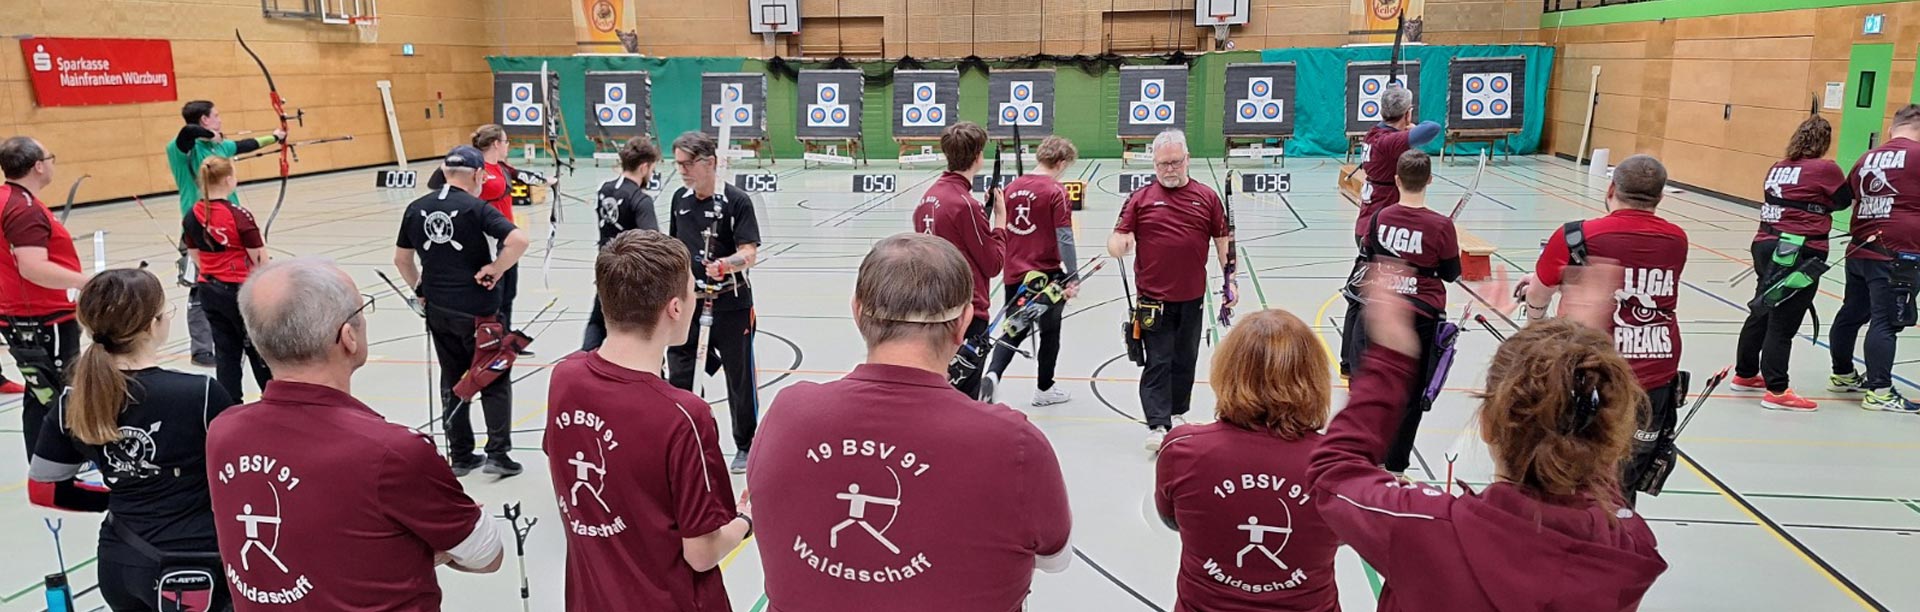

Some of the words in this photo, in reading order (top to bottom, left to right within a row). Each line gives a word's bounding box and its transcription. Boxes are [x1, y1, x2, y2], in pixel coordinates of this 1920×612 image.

[56, 57, 110, 73] Sparkasse
[60, 72, 123, 86] Mainfranken
[123, 72, 168, 86] Würzburg
[1863, 150, 1907, 169] LIGA
[385, 171, 416, 188] 000
[745, 174, 777, 191] 052
[863, 175, 895, 192] 050
[1254, 174, 1290, 192] 036
[1767, 166, 1802, 185] LIGA
[1378, 224, 1423, 254] LIGA
[1624, 267, 1674, 296] LIGA
[1614, 325, 1673, 354] FREAKS
[556, 411, 571, 429] 19
[574, 410, 605, 432] BSV
[603, 429, 619, 451] 91
[218, 462, 235, 484] 19
[239, 454, 276, 474] BSV
[277, 466, 300, 491] 91
[806, 442, 833, 463] 19
[842, 439, 896, 460] BSV
[900, 452, 930, 477] 91
[1213, 479, 1236, 499] 19
[1241, 473, 1286, 491] BSV
[1288, 484, 1311, 505] 91
[793, 535, 932, 583] Waldaschaff
[227, 563, 314, 604] Waldaschaff
[1203, 557, 1308, 593] Waldaschaff
